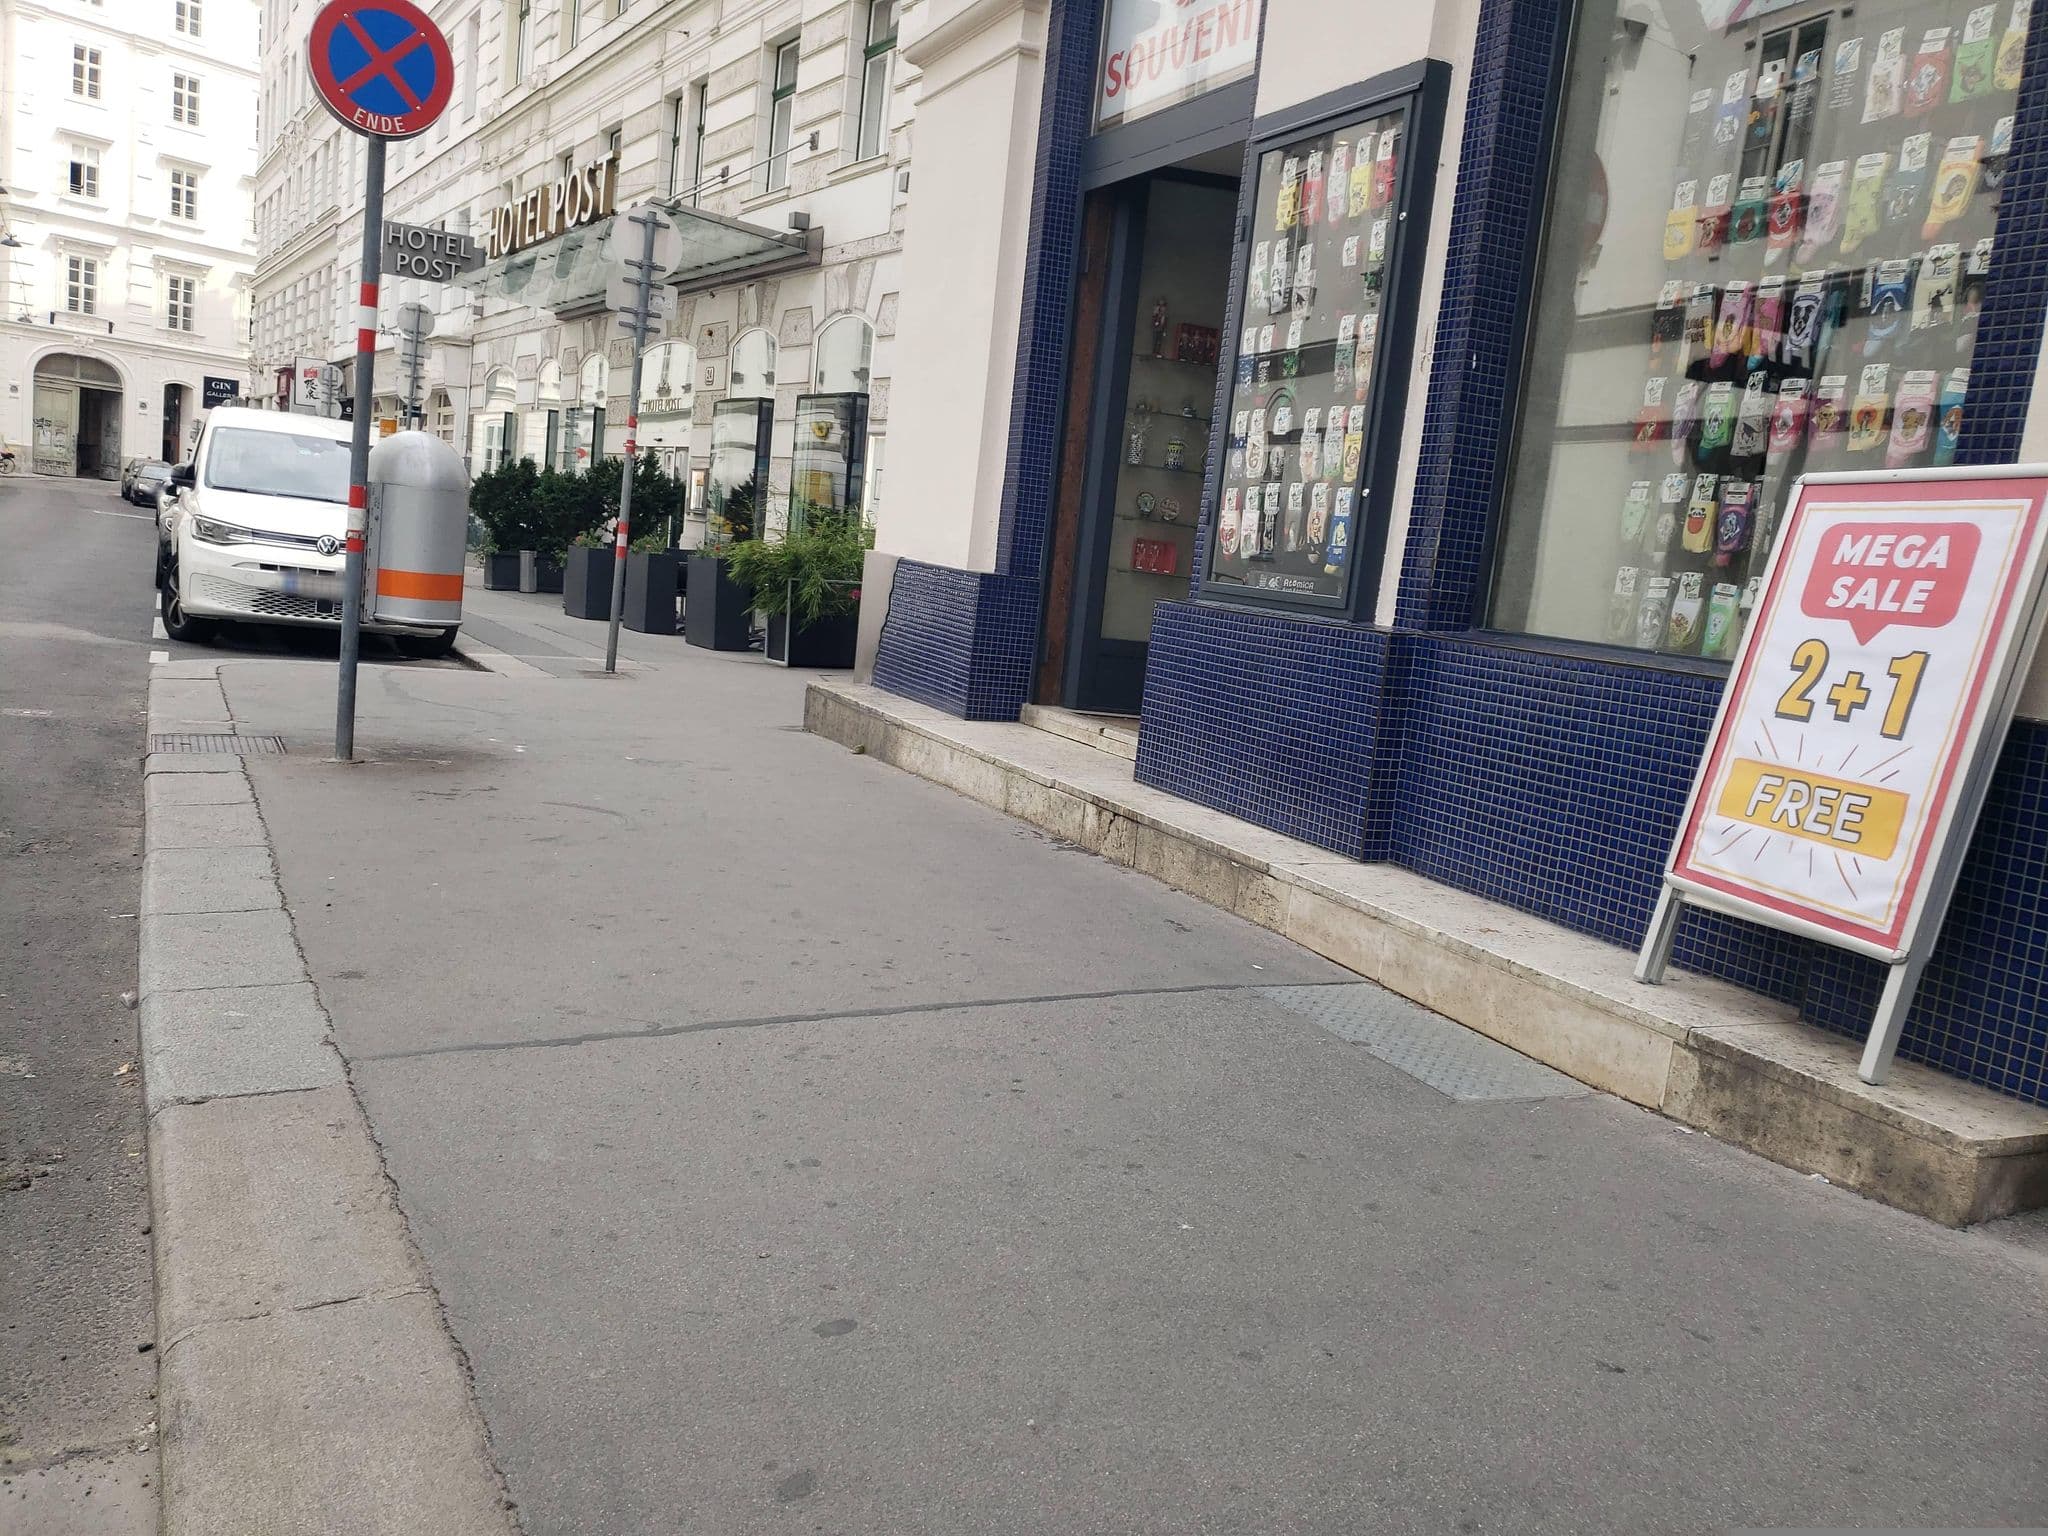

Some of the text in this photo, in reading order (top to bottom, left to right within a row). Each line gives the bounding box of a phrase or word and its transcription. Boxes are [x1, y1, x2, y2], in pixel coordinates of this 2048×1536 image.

[353, 107, 406, 133] ENDE
[488, 149, 616, 259] HOTEL POST
[387, 224, 472, 259] HOTEL
[395, 252, 462, 281] POST
[211, 380, 232, 391] GIN
[1832, 534, 1950, 569] MEGA
[1825, 575, 1937, 614] SALE
[1745, 773, 1872, 844] FREE
